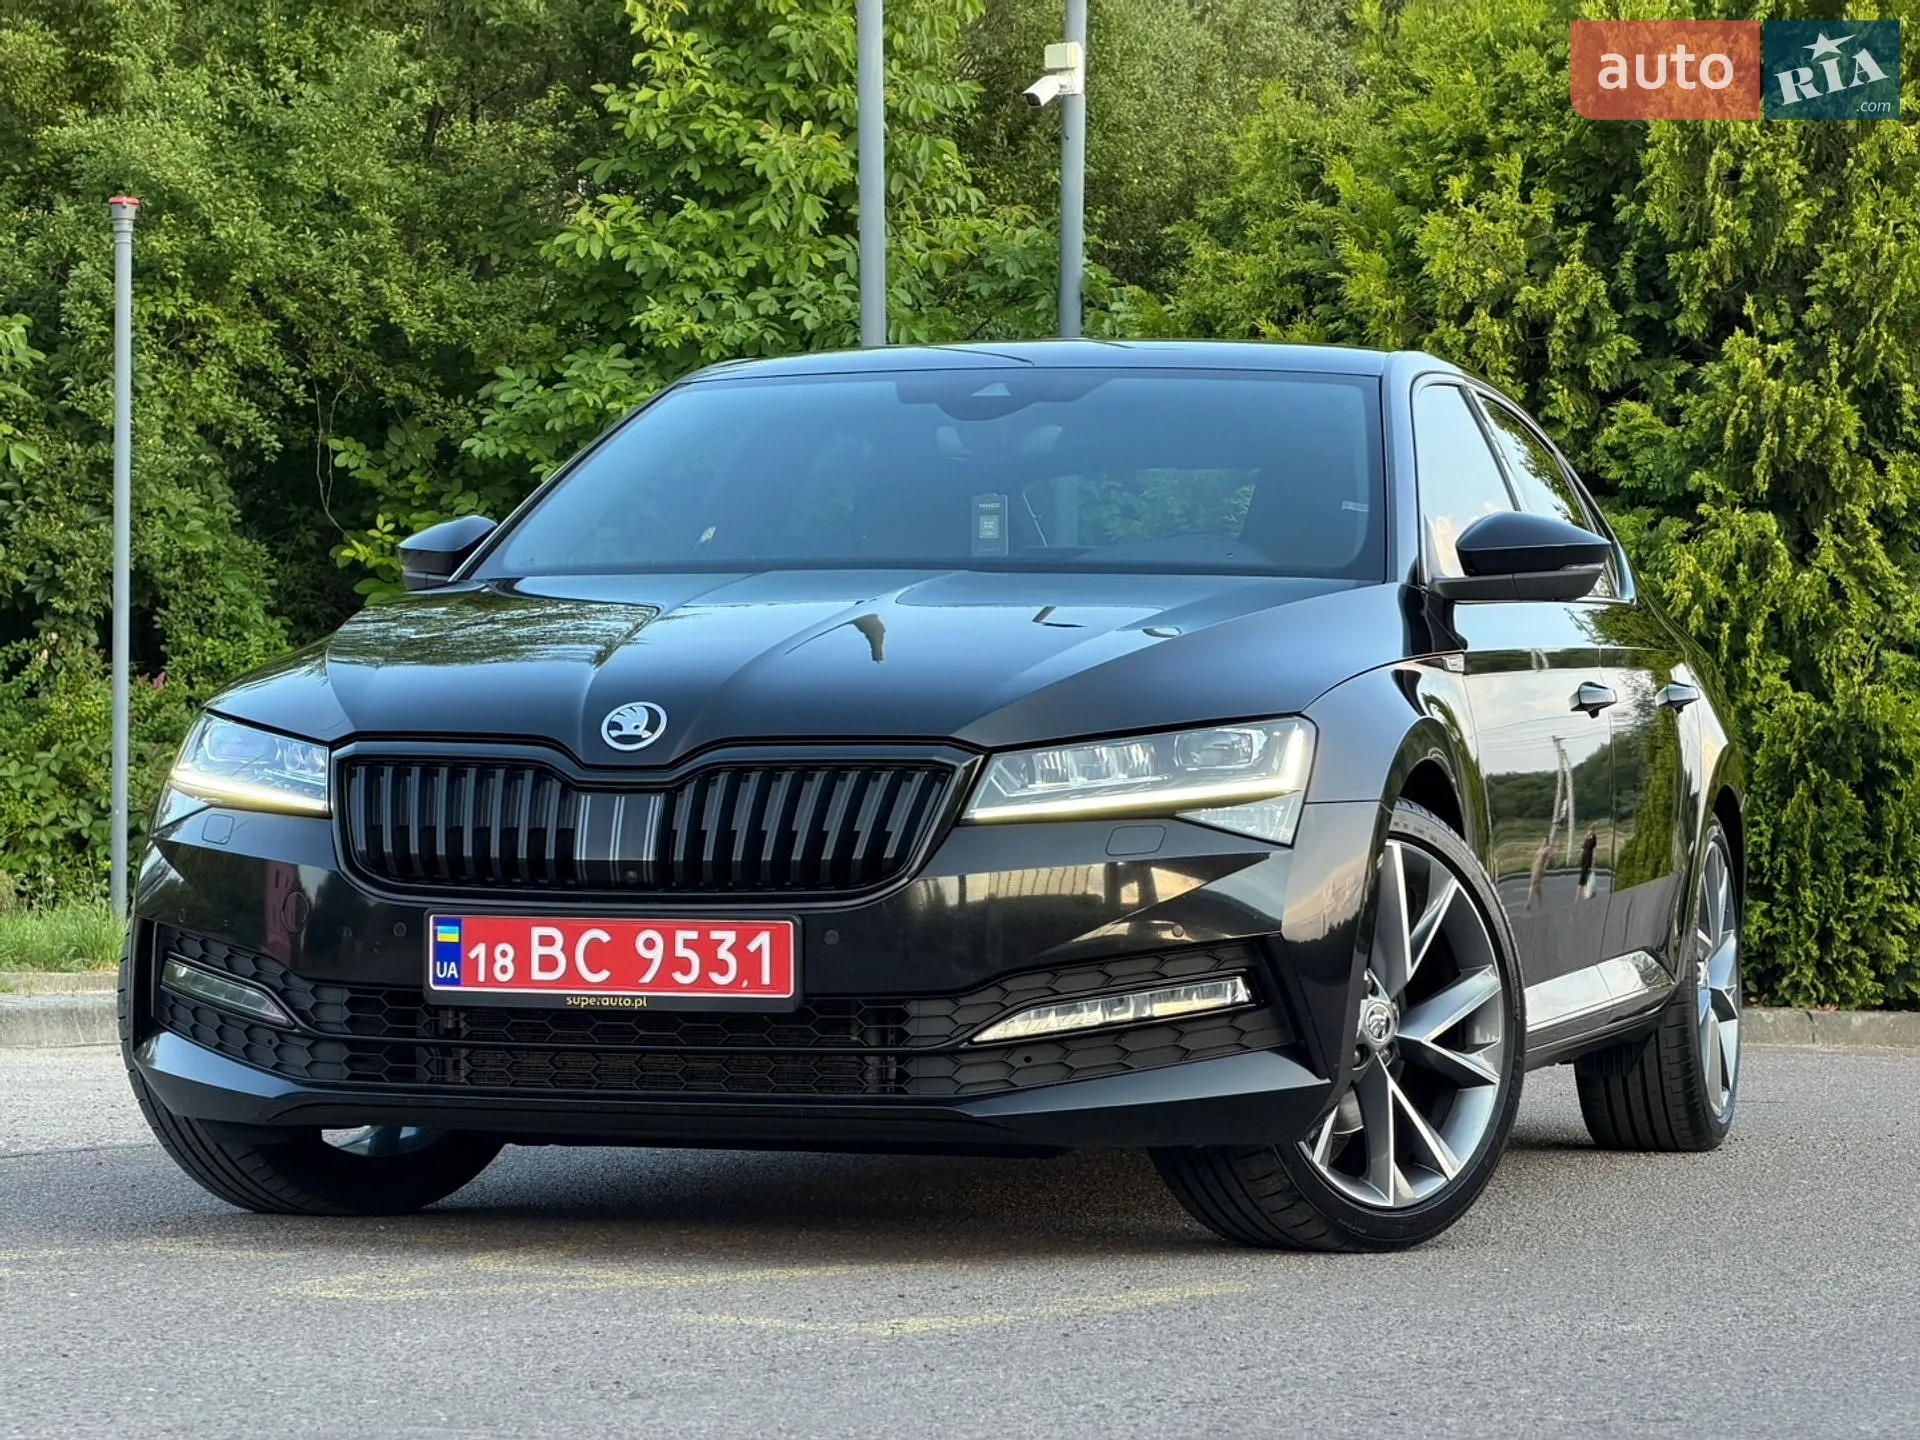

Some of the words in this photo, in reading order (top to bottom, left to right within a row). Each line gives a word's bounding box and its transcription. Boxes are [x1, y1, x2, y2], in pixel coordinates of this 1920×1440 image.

[467, 943, 516, 983] 18
[530, 926, 612, 984] BC
[634, 930, 772, 986] 9531
[436, 962, 459, 978] UA
[566, 995, 648, 1009] superauto.pl
